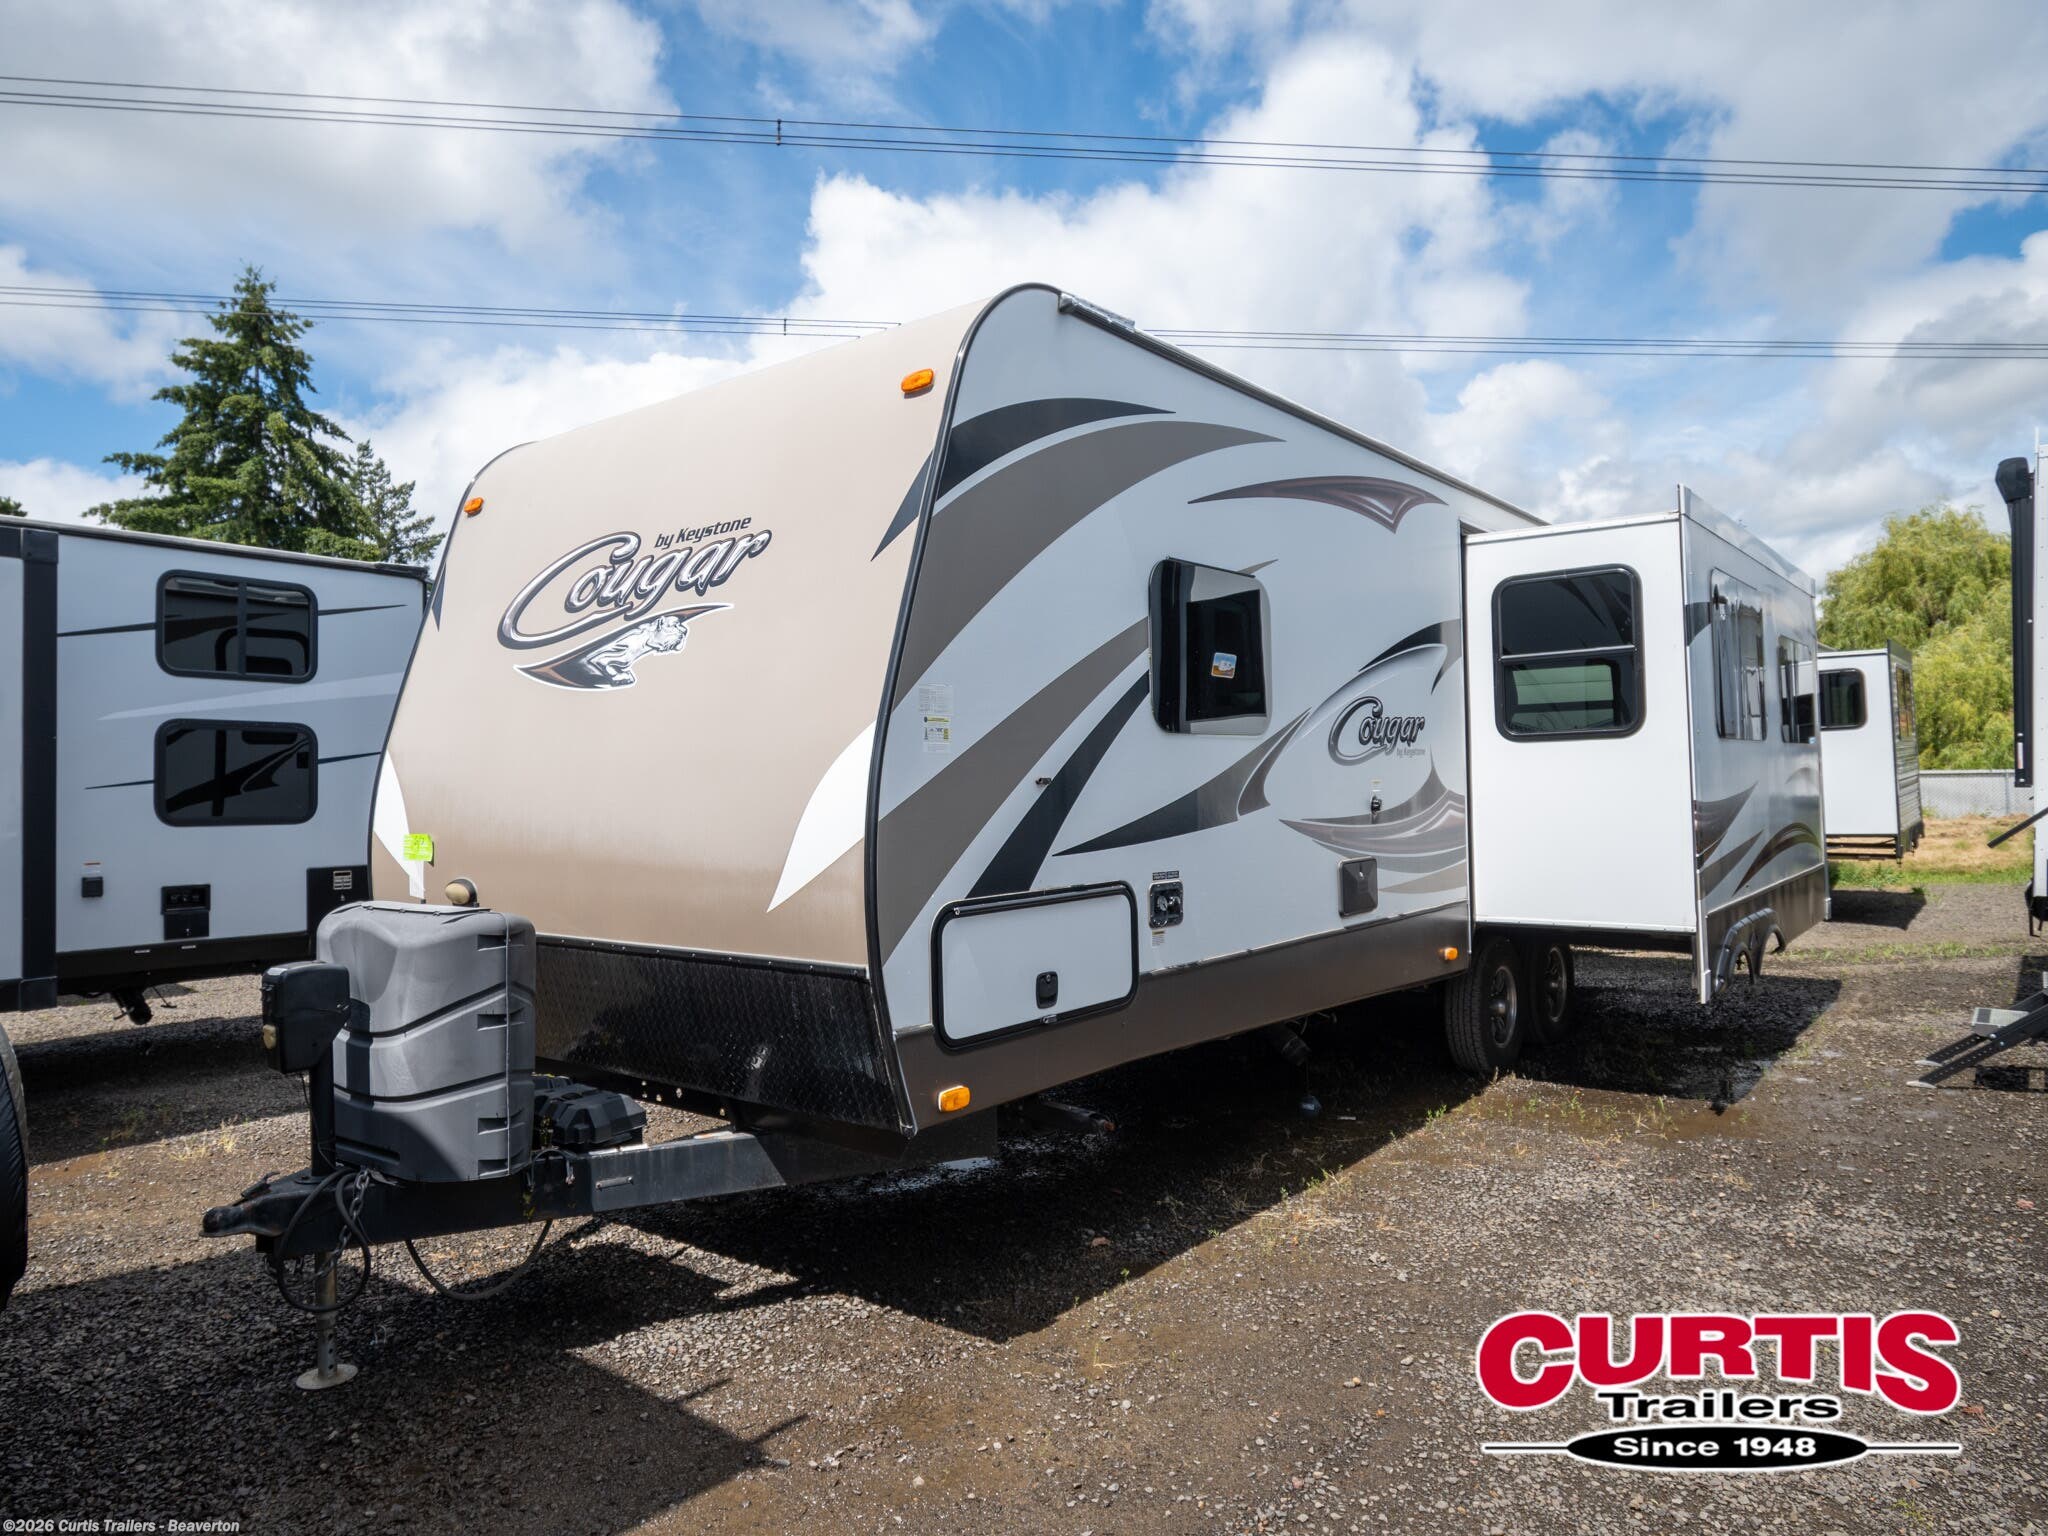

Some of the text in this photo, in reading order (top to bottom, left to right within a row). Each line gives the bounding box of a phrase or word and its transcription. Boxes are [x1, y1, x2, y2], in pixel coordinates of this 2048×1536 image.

[654, 516, 752, 549] by Keystone
[497, 529, 773, 650] Cougar
[1328, 696, 1425, 767] Cougar
